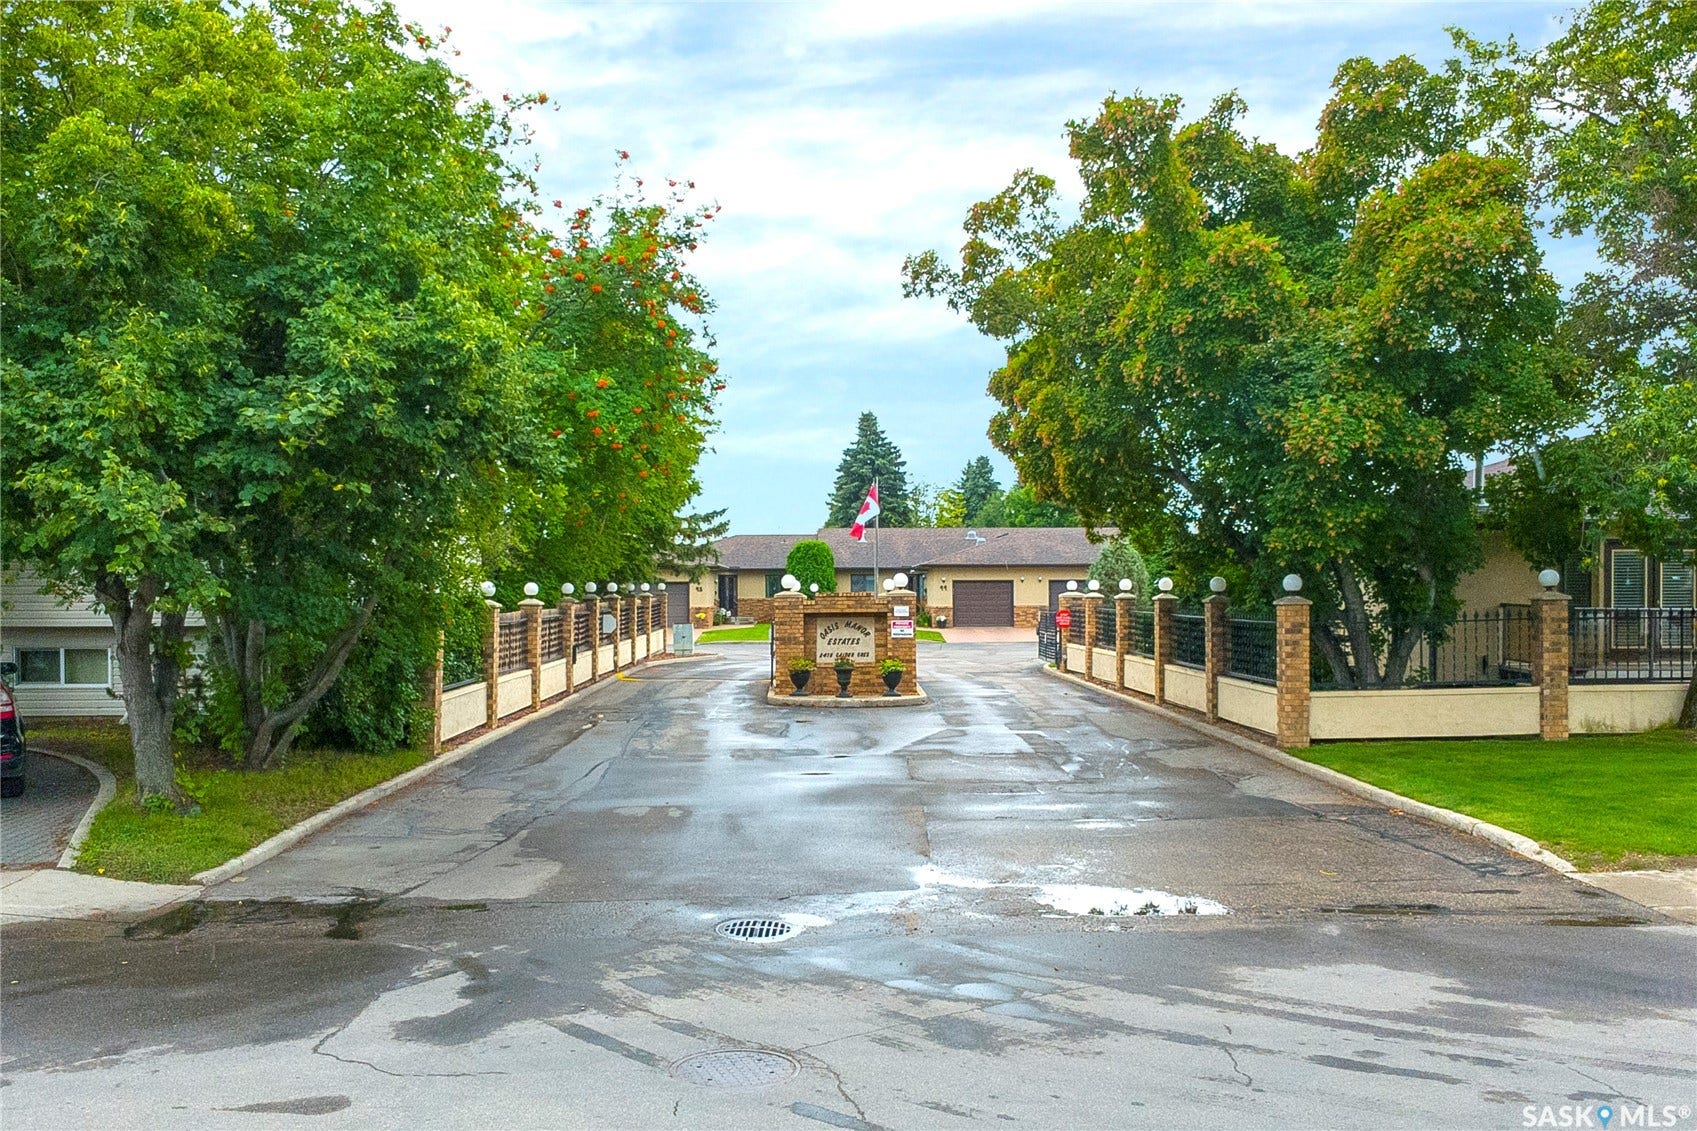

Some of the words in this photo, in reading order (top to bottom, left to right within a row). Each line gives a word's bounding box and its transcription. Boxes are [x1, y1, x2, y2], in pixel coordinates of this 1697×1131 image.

[820, 622, 840, 640] OASIS
[844, 620, 871, 638] MANOR
[827, 637, 860, 646] ESTATES
